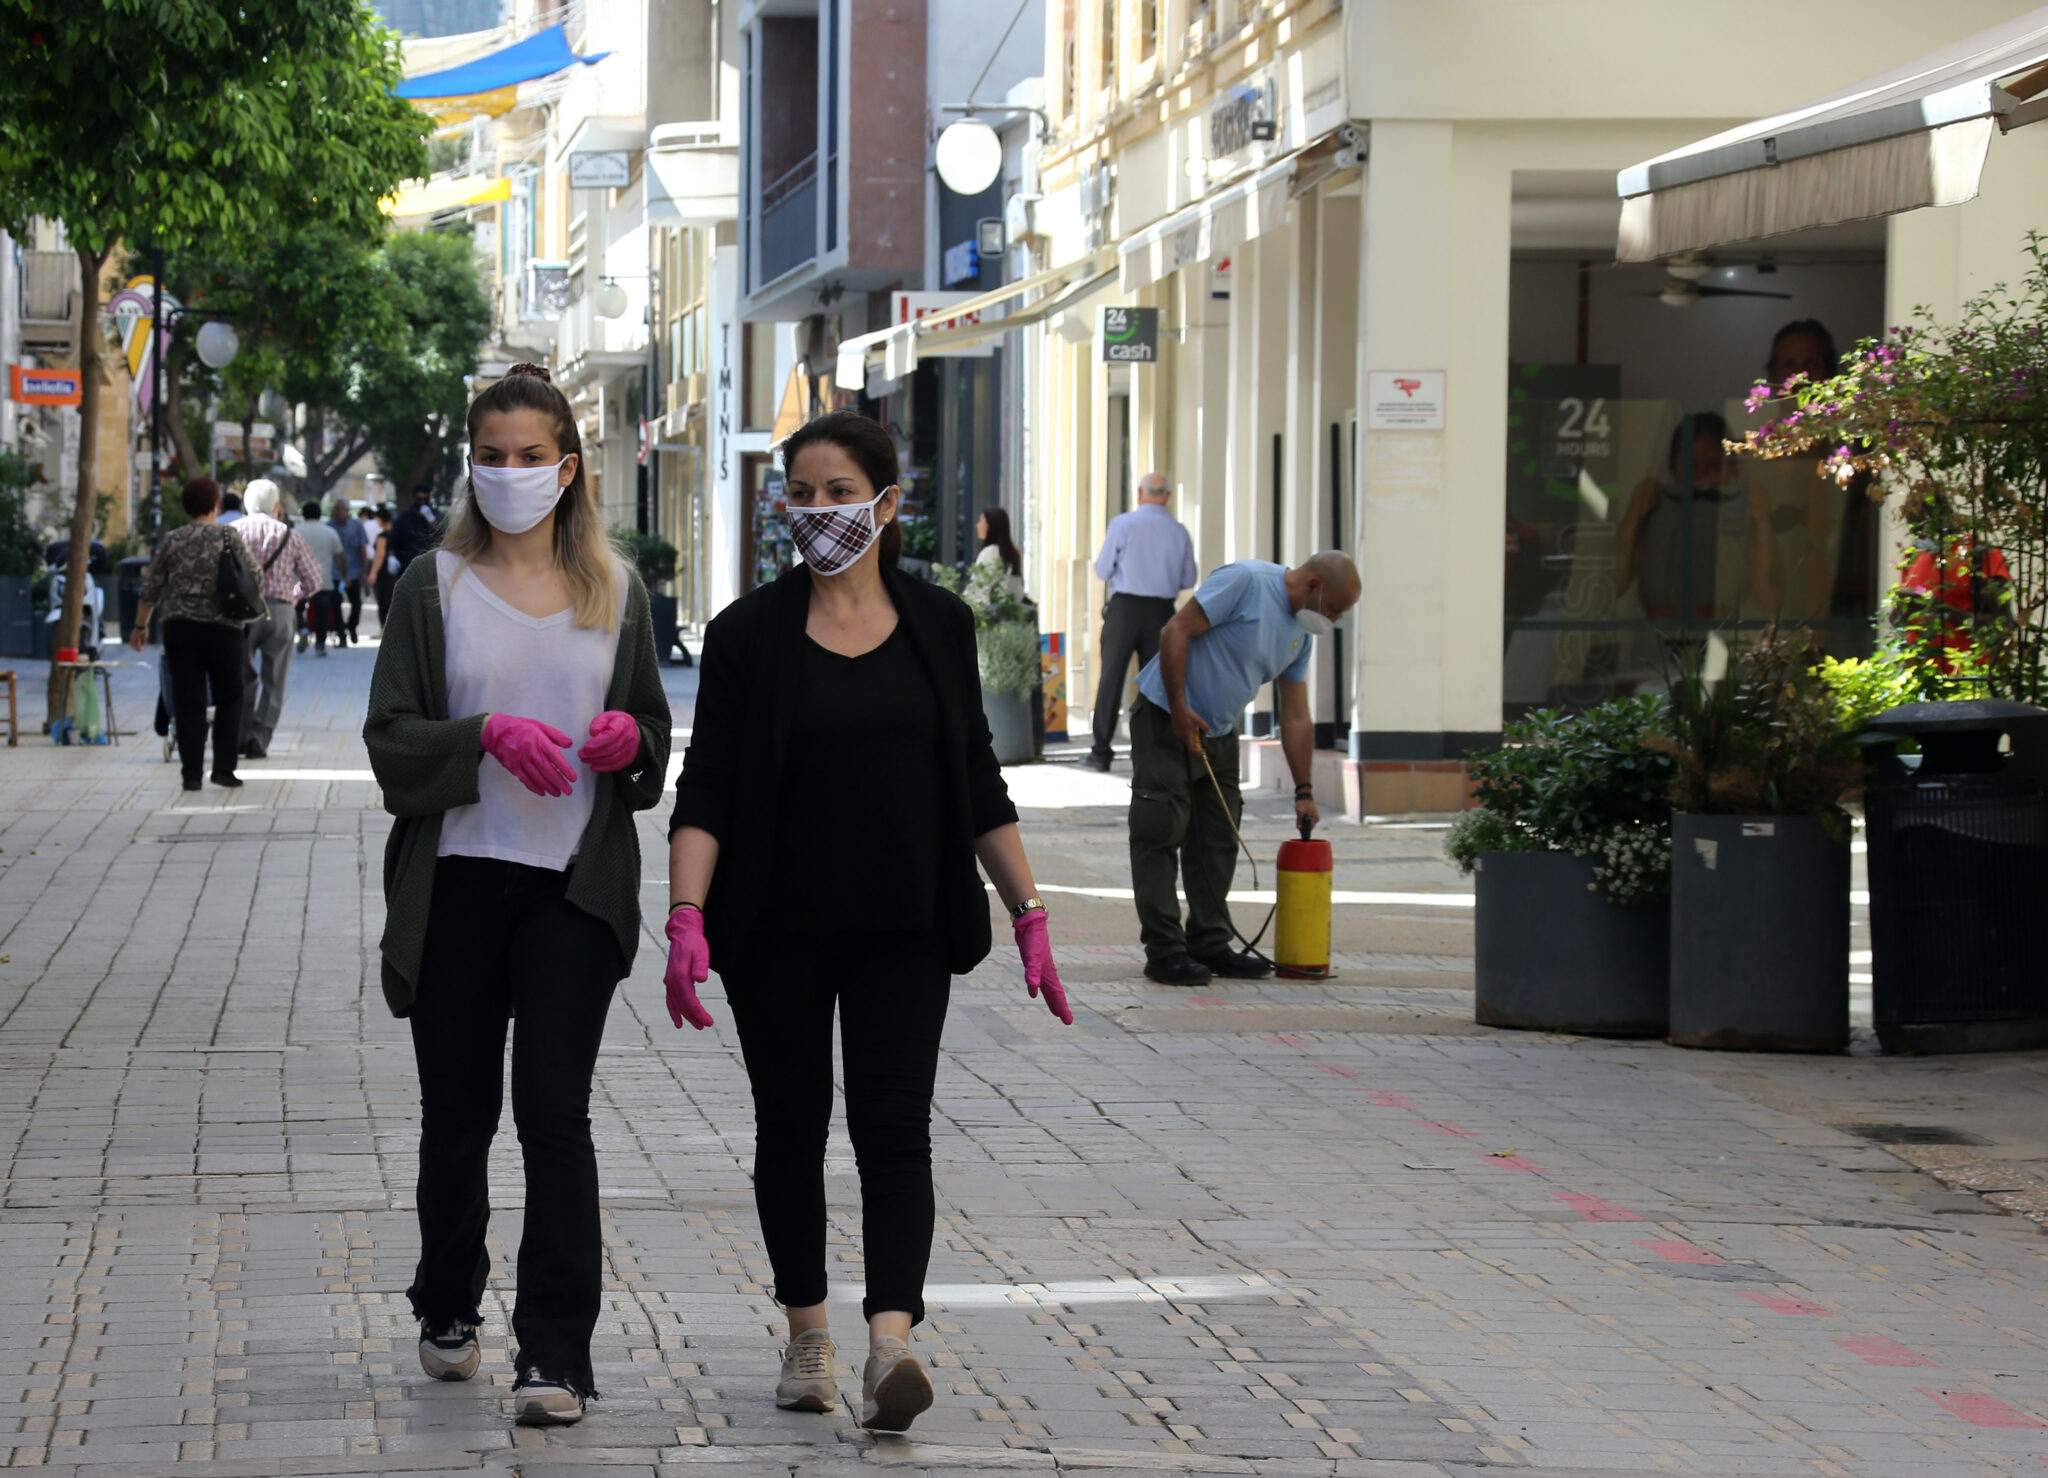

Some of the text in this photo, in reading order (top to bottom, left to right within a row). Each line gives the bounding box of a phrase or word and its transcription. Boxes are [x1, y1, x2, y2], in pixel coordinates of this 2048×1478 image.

[1107, 309, 1127, 325] 24
[1109, 342, 1151, 360] cash
[719, 323, 732, 481] TIMINIS
[1558, 398, 1611, 438] 24
[1556, 442, 1611, 457] HOURS
